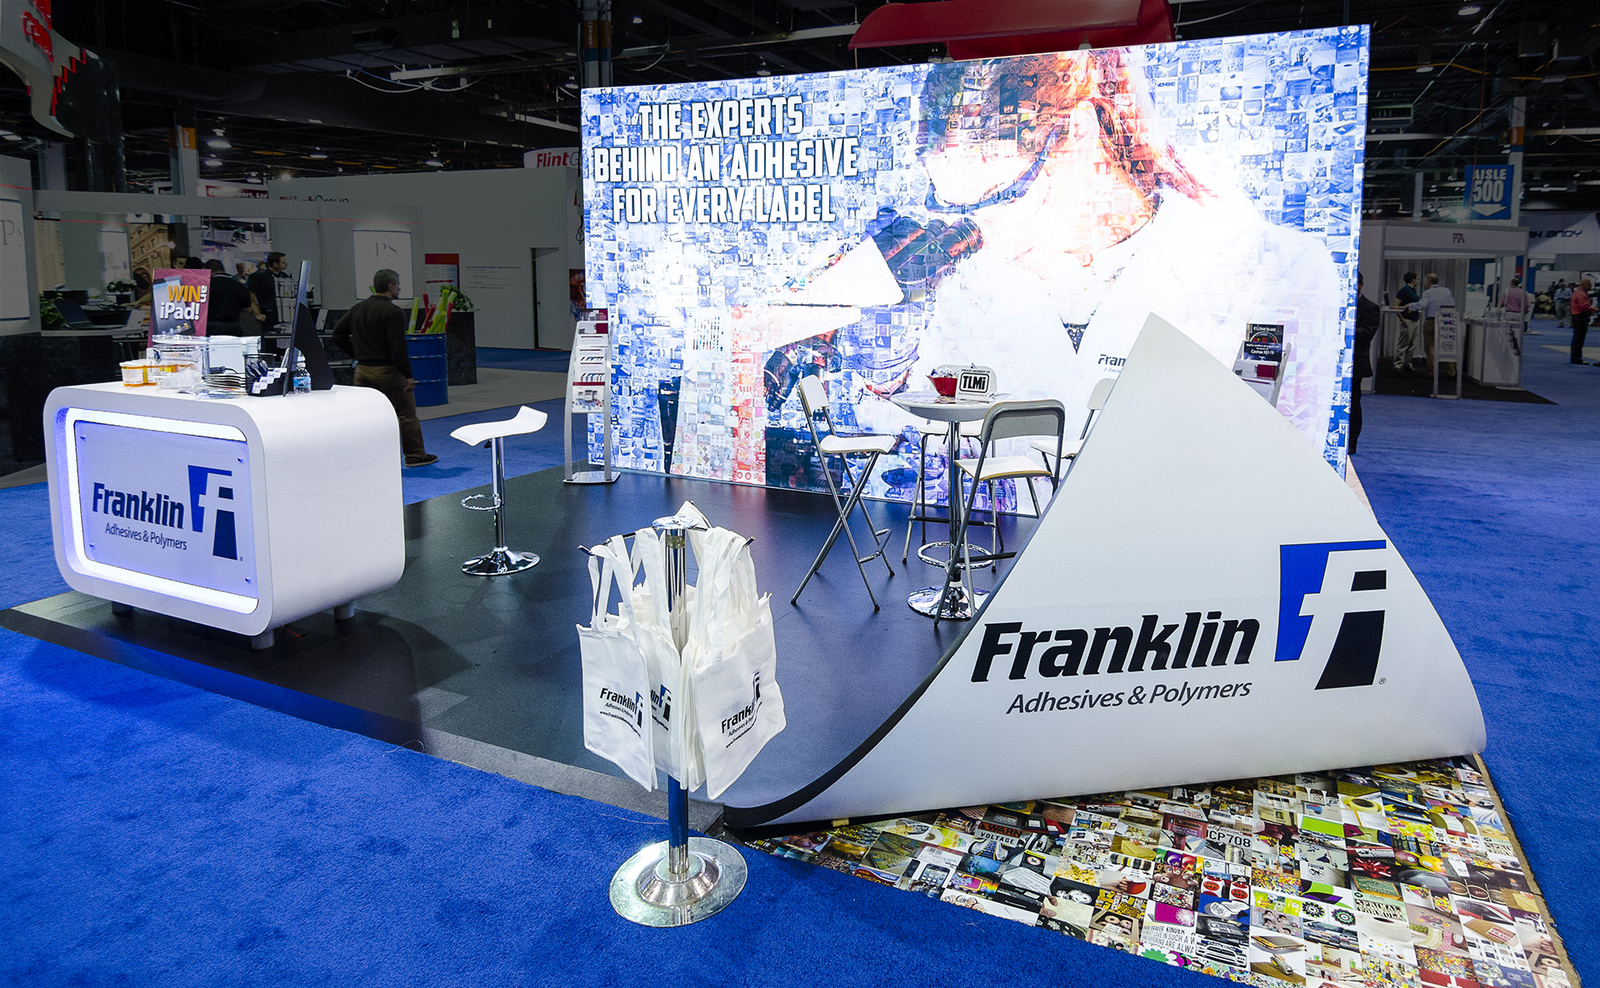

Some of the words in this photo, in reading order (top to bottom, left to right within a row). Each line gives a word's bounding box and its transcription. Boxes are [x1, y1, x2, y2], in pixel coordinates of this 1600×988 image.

[638, 103, 682, 140] THE
[691, 95, 803, 139] EXPERTS
[594, 146, 678, 183] BEHIND
[686, 143, 720, 181] AN
[730, 137, 859, 180] ADHESIVE
[1473, 168, 1507, 181] AISLE
[612, 187, 657, 223] FOR
[666, 186, 745, 223] EVERY
[756, 184, 836, 223] LABEL
[1472, 180, 1505, 203] 500
[168, 285, 200, 302] WIN
[160, 301, 200, 321] iPad!
[92, 481, 185, 530] Franklin
[105, 522, 141, 541] Adhesives
[142, 530, 149, 542] &
[150, 532, 187, 551] Polymers
[970, 610, 1261, 683] Franklin
[600, 687, 636, 712] Franklin
[1006, 692, 1123, 715] Adhesives
[1127, 685, 1145, 706] &
[1149, 680, 1252, 707] Polymers
[980, 832, 1014, 844] VOLTAGE
